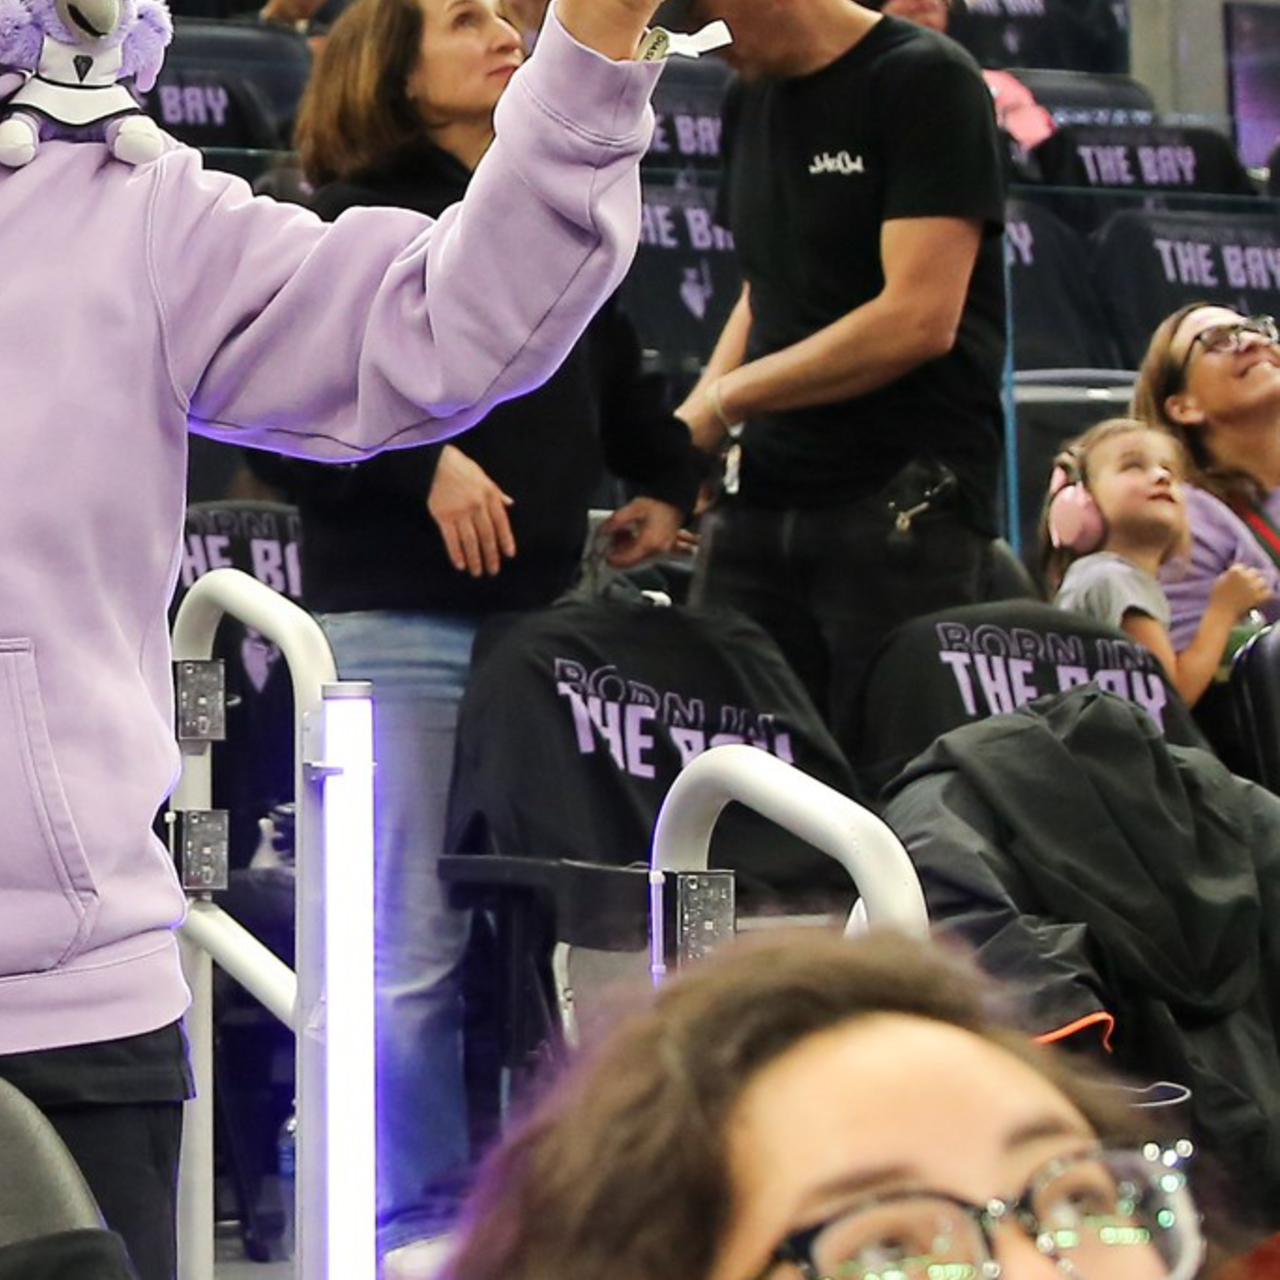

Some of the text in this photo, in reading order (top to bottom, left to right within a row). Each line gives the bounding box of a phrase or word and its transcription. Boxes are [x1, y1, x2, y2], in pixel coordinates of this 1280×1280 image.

[161, 86, 230, 126] BAY
[1077, 145, 1195, 184] THE BAY
[1154, 238, 1218, 287] THE
[182, 534, 233, 588] HE
[936, 622, 1087, 667] BORN
[554, 657, 704, 728] BORN
[939, 651, 1038, 715] THE
[556, 681, 656, 779] THE
